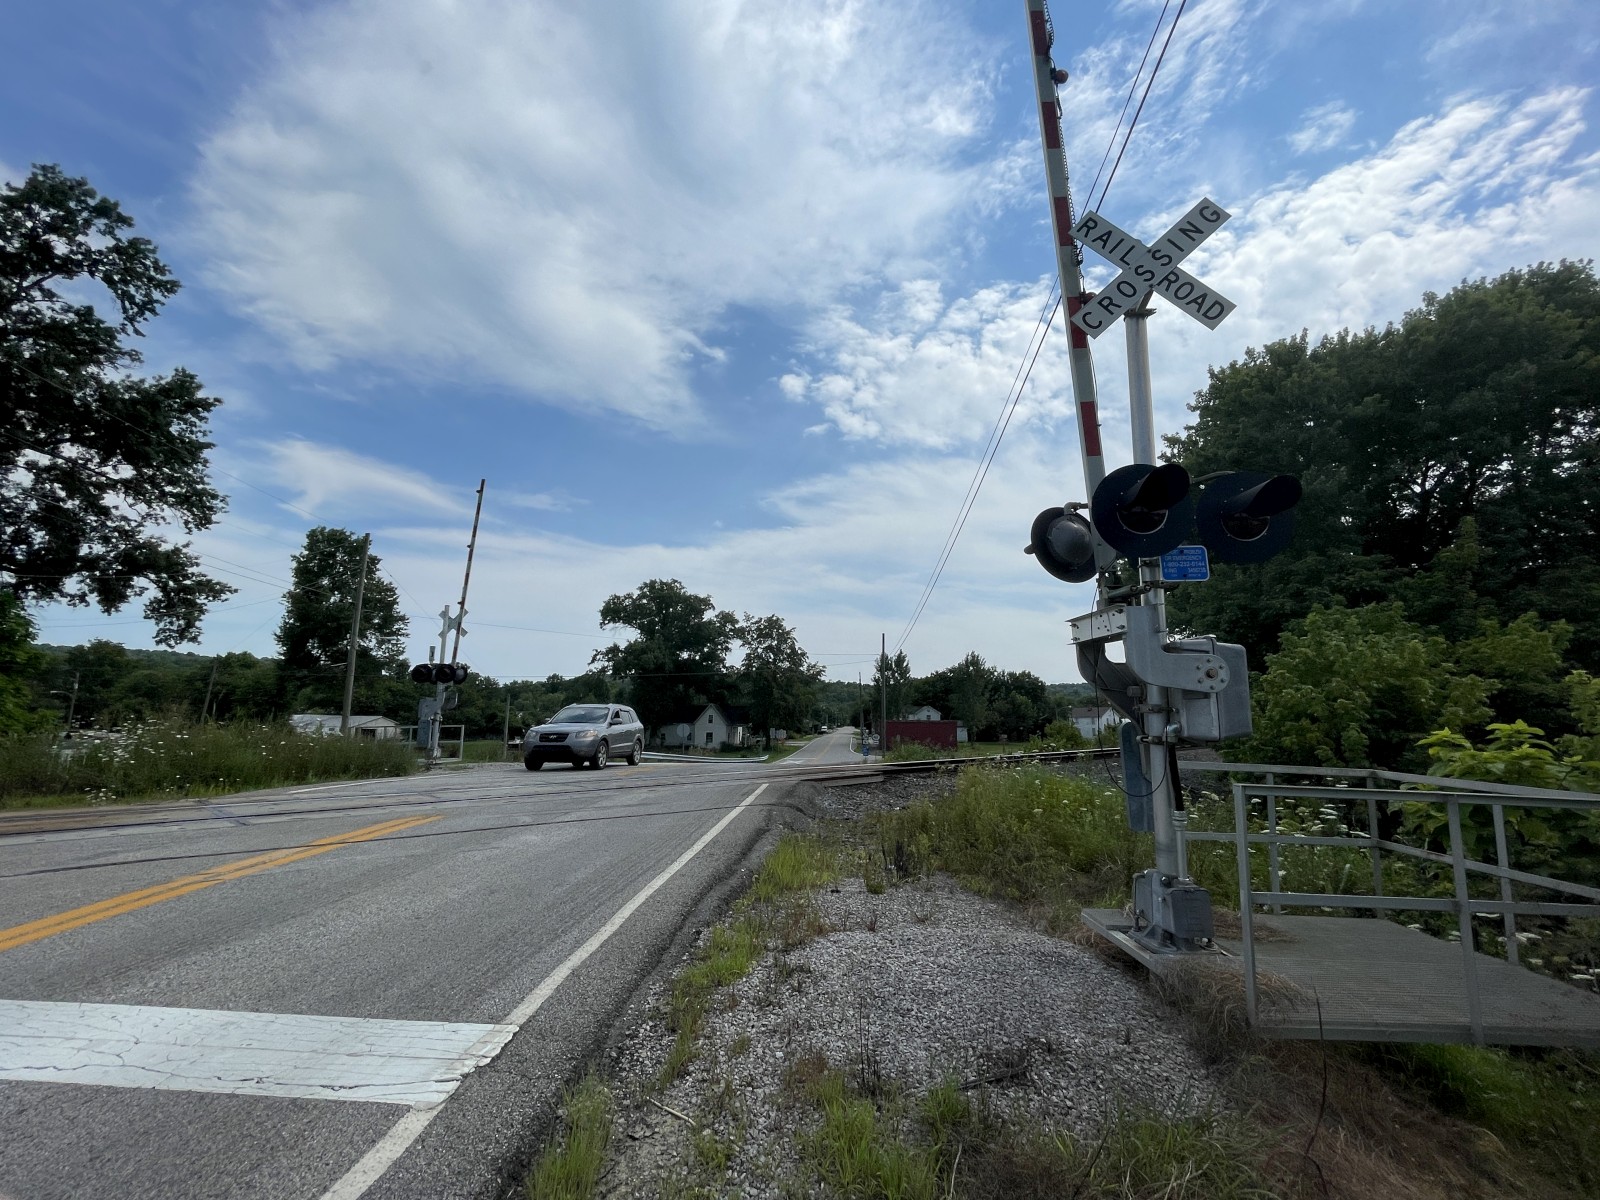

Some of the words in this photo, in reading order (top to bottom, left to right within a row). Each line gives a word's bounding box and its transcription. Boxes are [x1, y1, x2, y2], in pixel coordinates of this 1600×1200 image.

[1076, 216, 1136, 267] RAIL
[1155, 270, 1225, 321] ROAD
[1081, 205, 1221, 330] CROSSING
